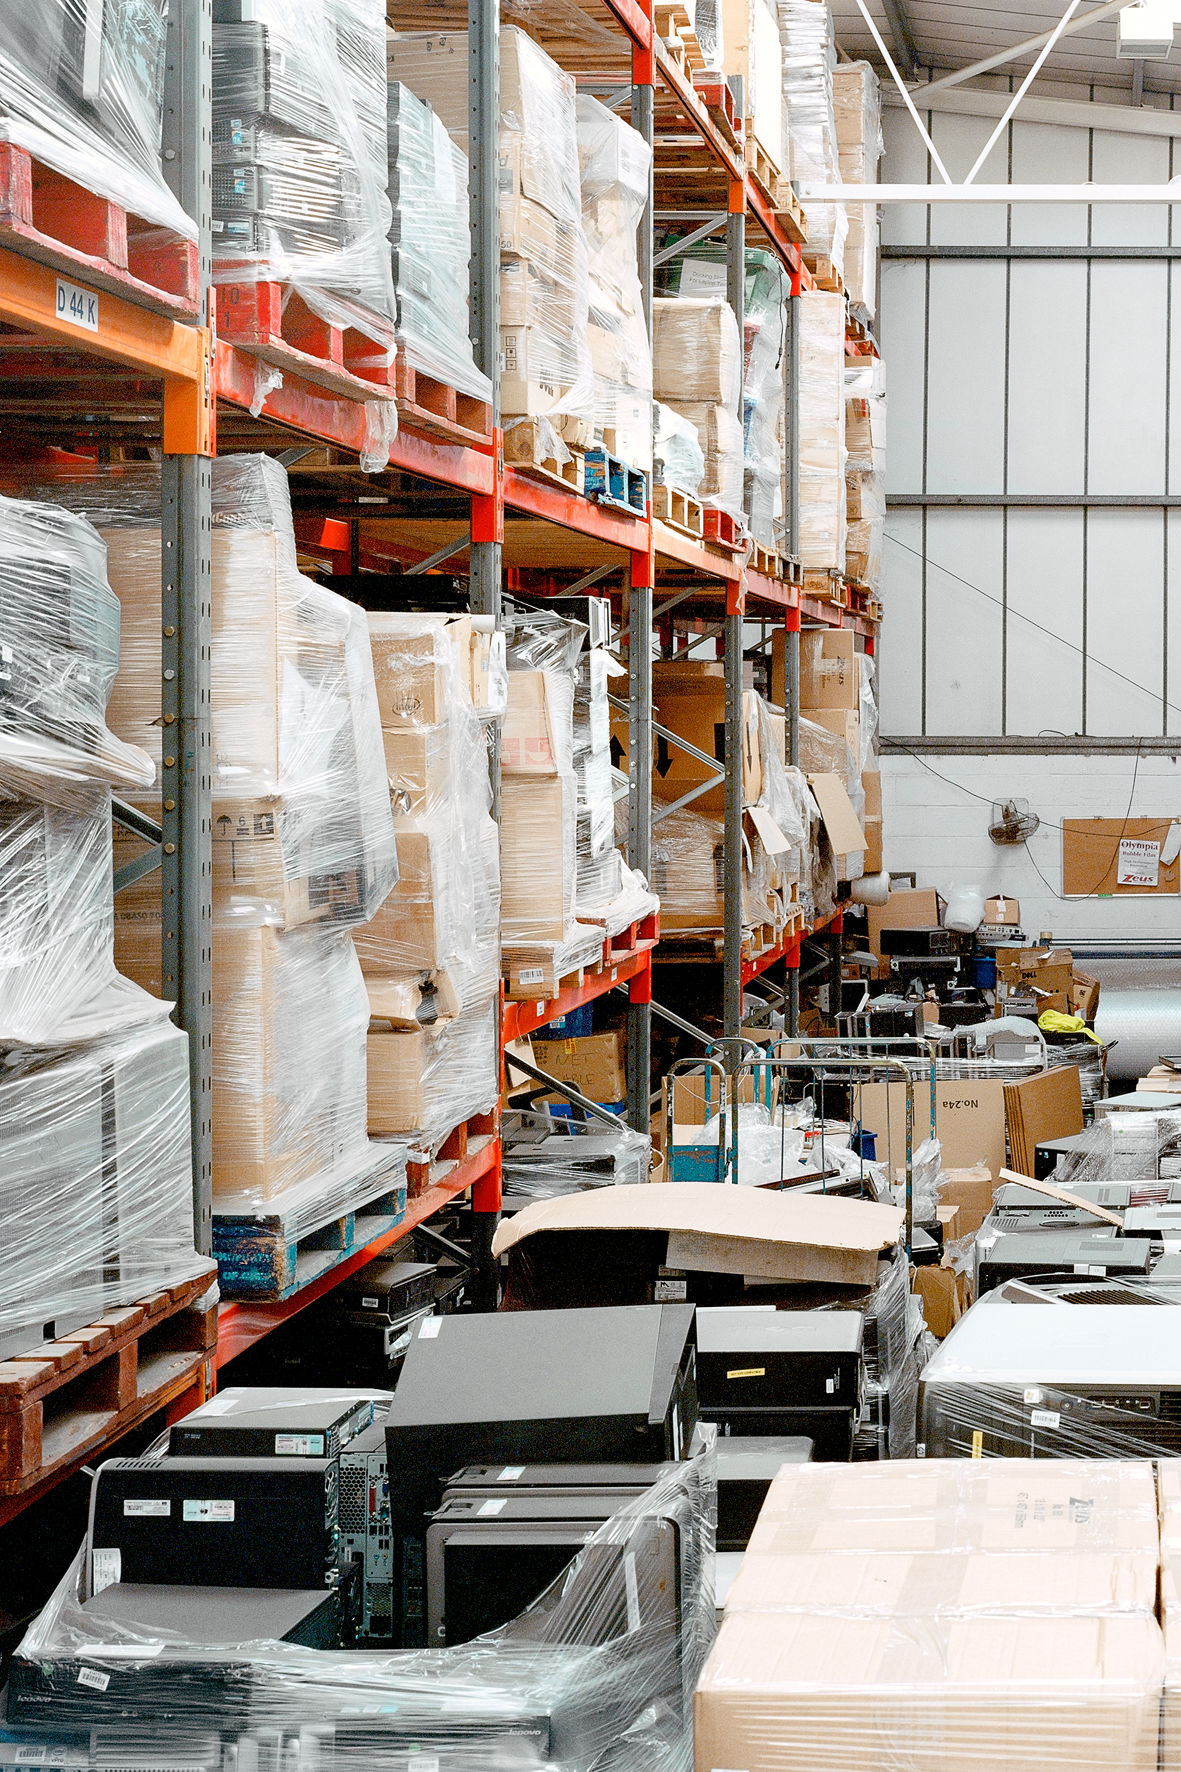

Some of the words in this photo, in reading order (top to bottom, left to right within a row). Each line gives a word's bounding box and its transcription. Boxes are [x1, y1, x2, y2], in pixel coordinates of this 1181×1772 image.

[58, 286, 65, 312] D
[70, 291, 84, 320] 44
[88, 298, 96, 325] K
[1121, 841, 1158, 851] Olympia
[1121, 874, 1155, 883] Zeus
[1021, 970, 1037, 979] DELL
[942, 1099, 979, 1109] No.24a
[17, 1694, 53, 1703] lenovo
